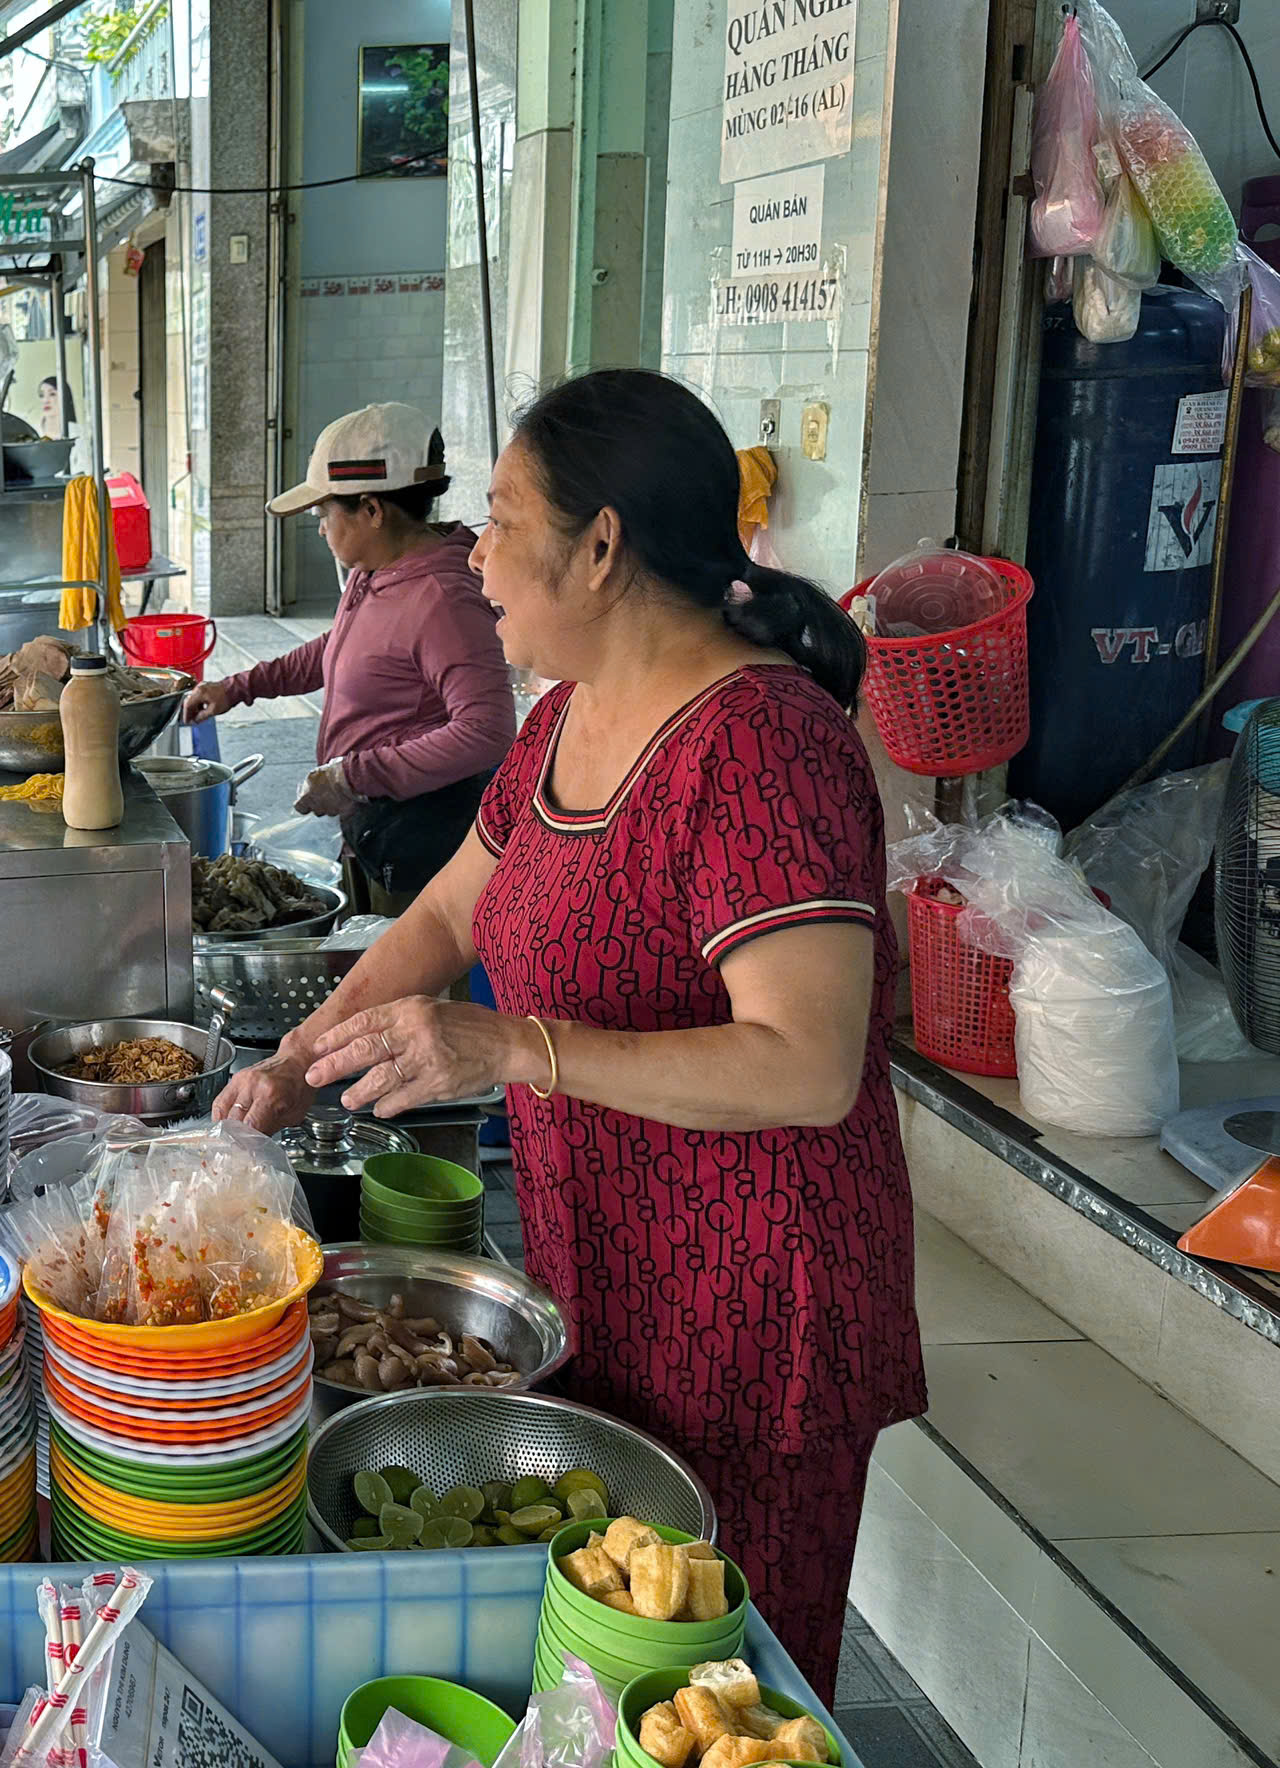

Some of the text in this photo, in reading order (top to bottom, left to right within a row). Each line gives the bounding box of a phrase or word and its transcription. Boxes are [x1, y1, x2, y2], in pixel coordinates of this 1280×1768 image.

[728, 0, 852, 55] QUÁN NG
[726, 33, 849, 100] HÀNG THÁNG
[726, 107, 767, 140] MÙNG
[812, 82, 846, 118] (AL)
[749, 193, 807, 224] QUÁN BÁN
[737, 243, 817, 269] TỪ 11H 20H30
[745, 282, 779, 313] 0908
[781, 279, 837, 312] 414157
